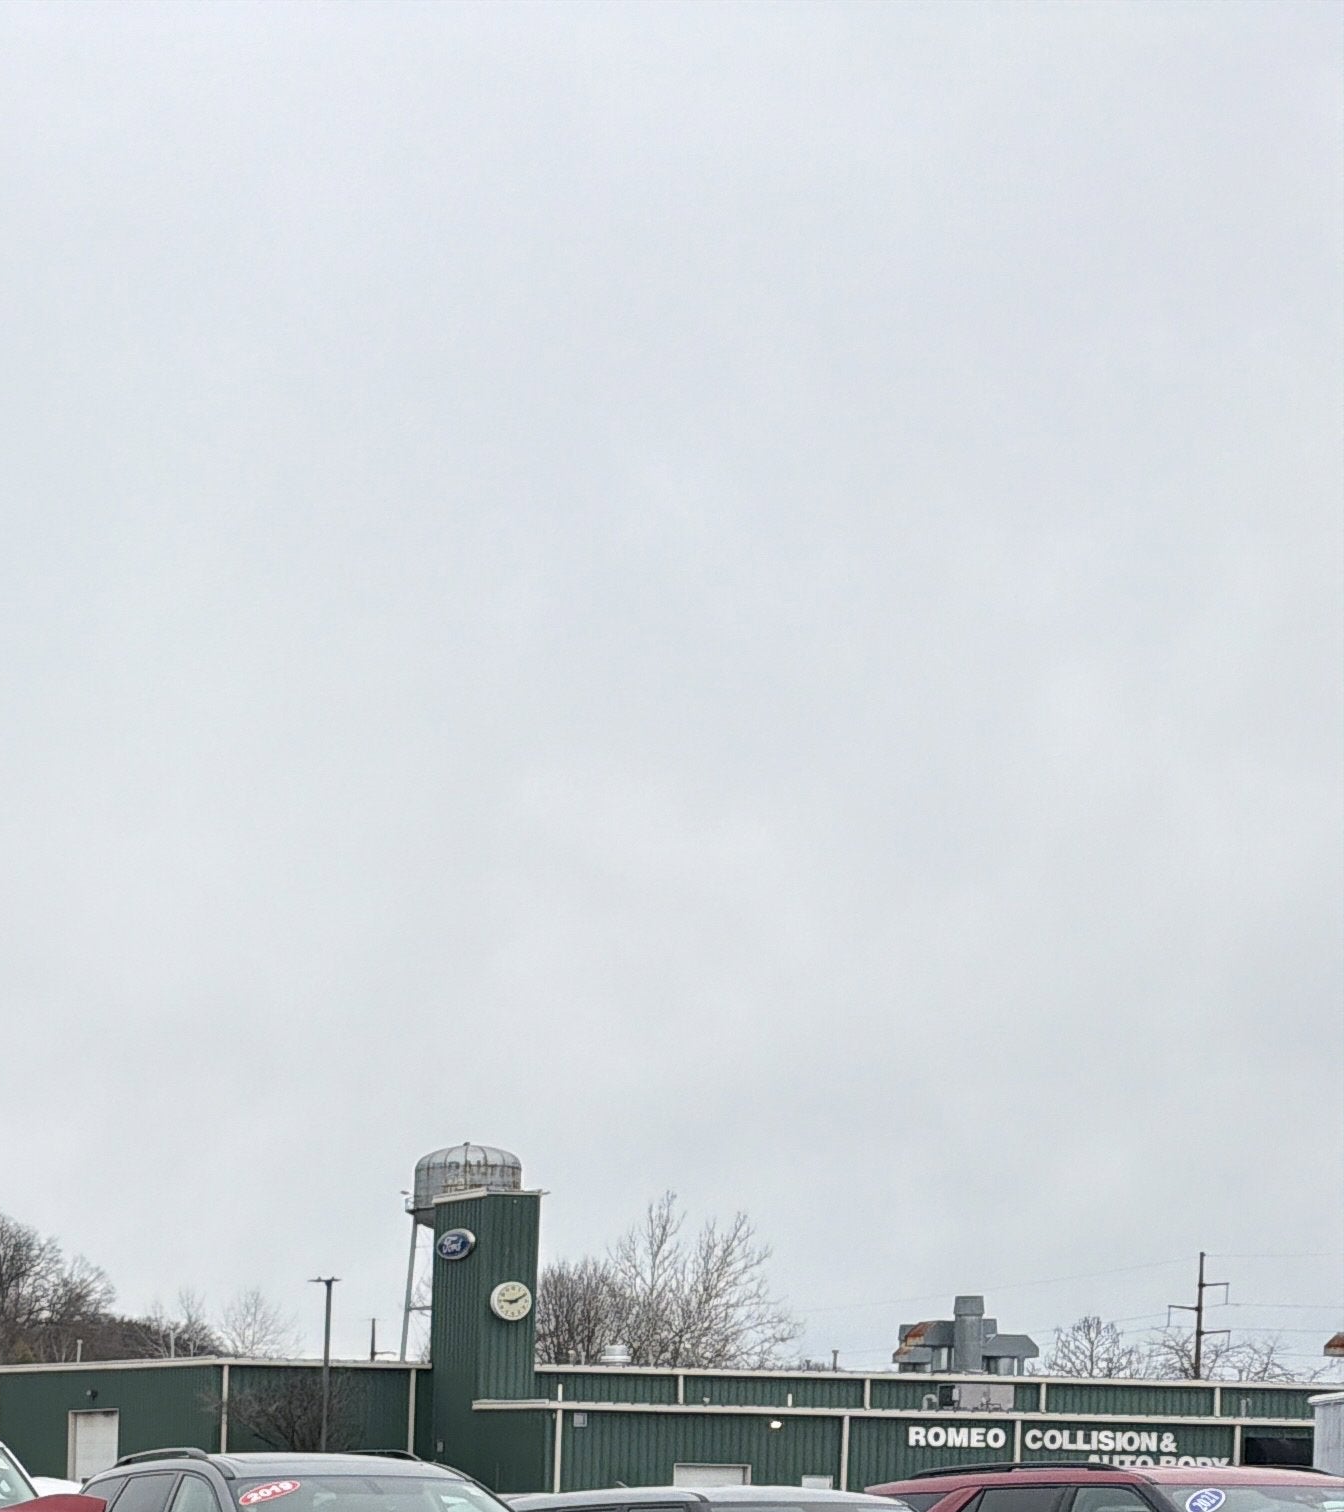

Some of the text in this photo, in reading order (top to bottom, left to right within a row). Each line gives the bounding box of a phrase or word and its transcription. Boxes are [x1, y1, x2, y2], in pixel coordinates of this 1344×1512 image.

[908, 1426, 1178, 1453] ROMEO COLLISION &
